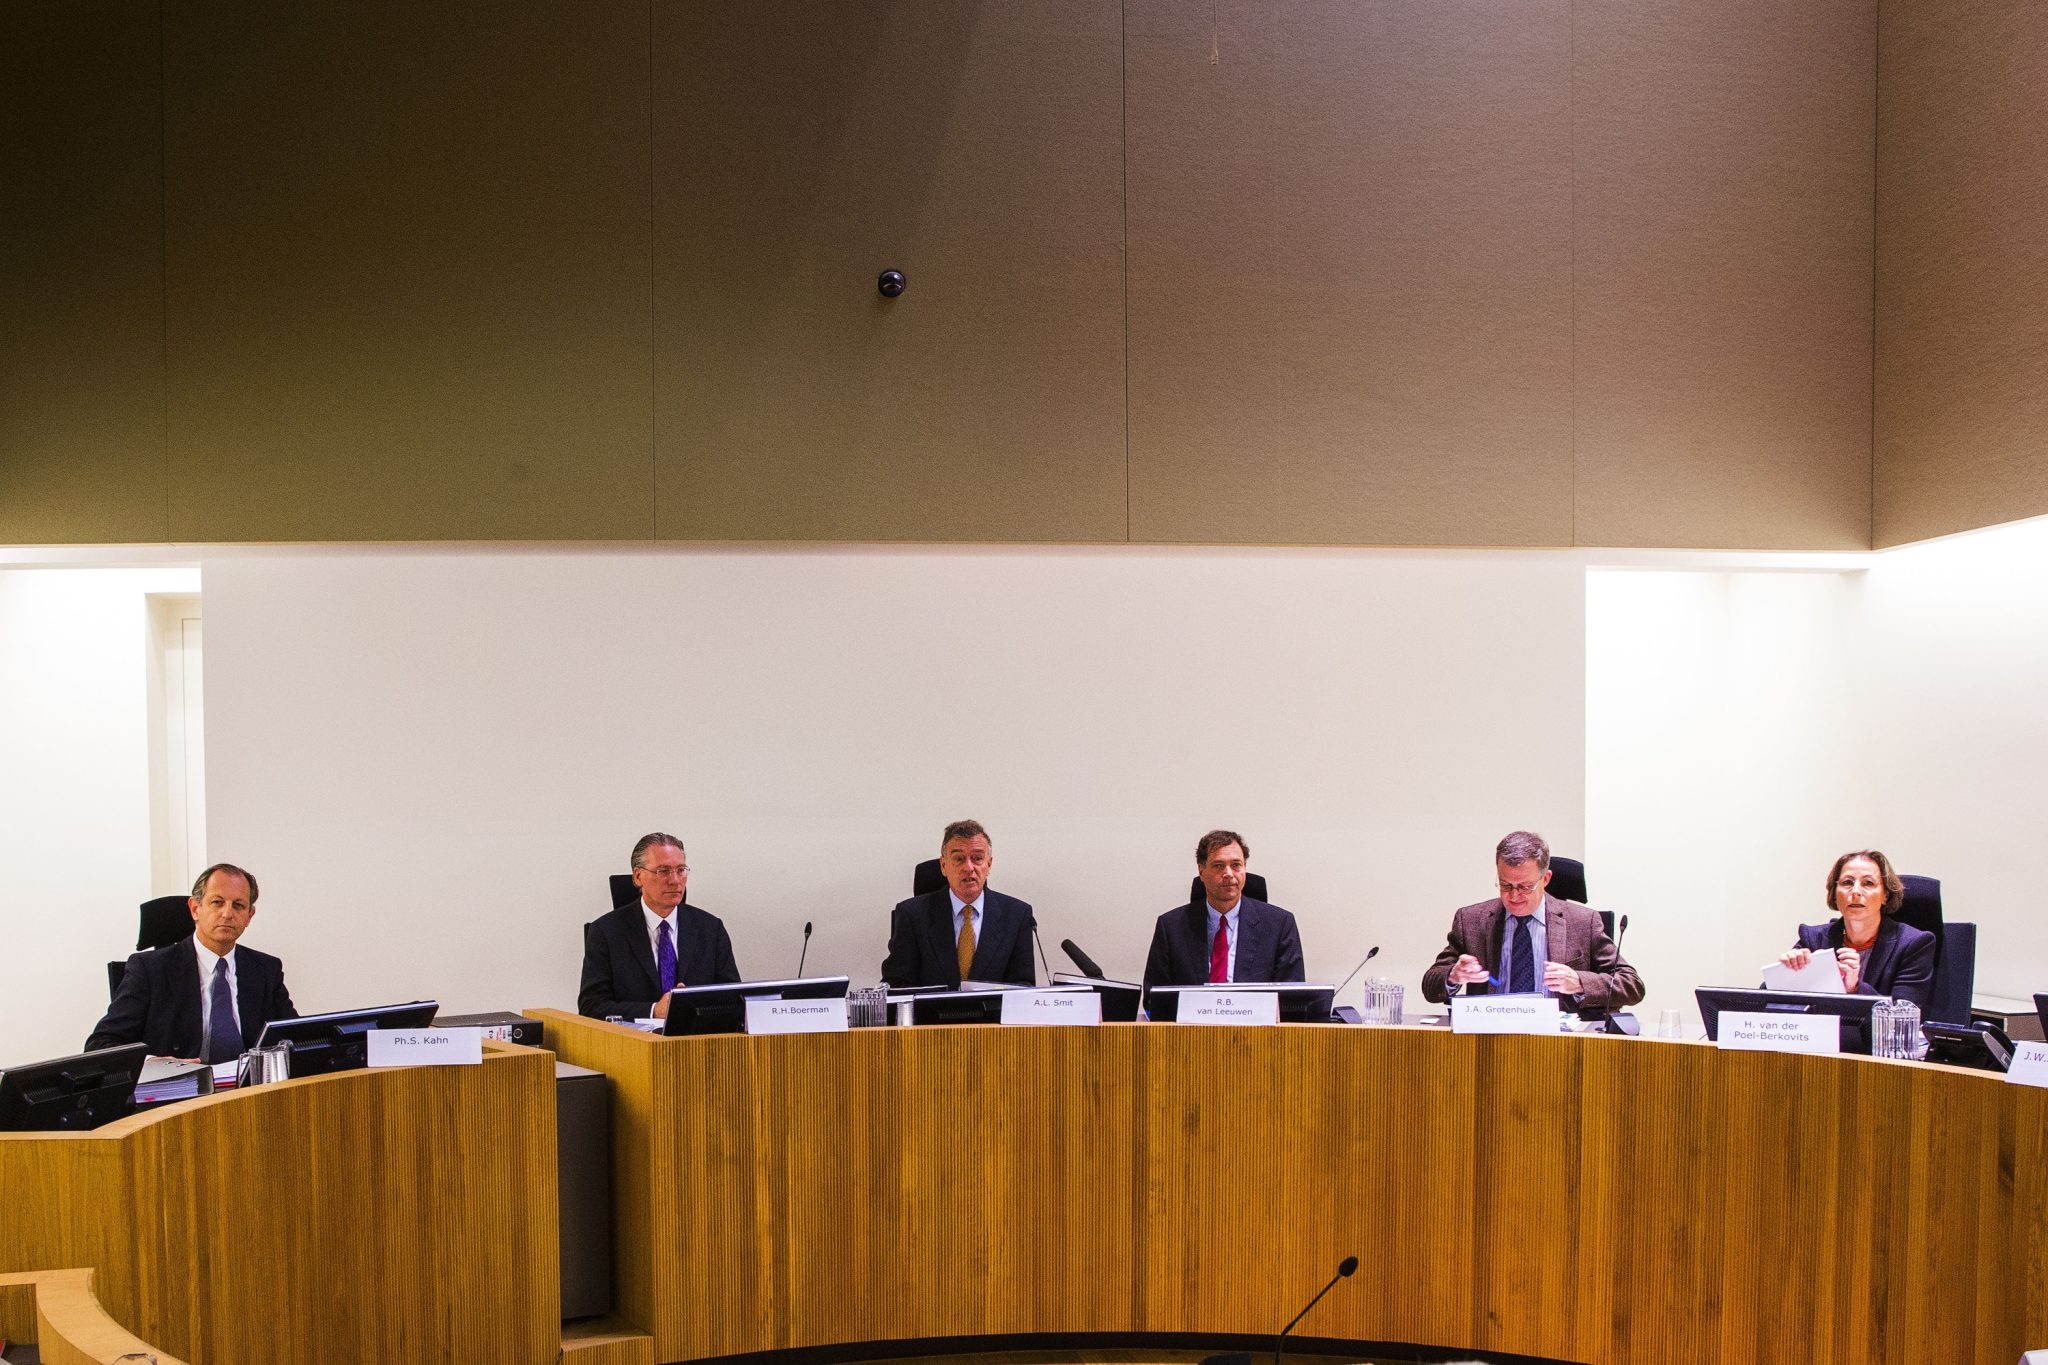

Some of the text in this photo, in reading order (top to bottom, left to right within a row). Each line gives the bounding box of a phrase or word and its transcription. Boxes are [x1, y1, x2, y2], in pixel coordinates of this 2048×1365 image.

[1034, 999, 1073, 1007] A.L. Smit
[1216, 998, 1234, 1006] R.B.
[1215, 1008, 1253, 1016] Leeuwen
[1465, 1005, 1536, 1014] J.A. Grotenhuis
[1744, 1020, 1756, 1029] H.
[1781, 1022, 1799, 1030] der
[1734, 1030, 1809, 1041] Poel-Berkovits
[394, 1036, 449, 1045] Ph.S. Kahn
[2023, 1051, 2048, 1063] J.W.
